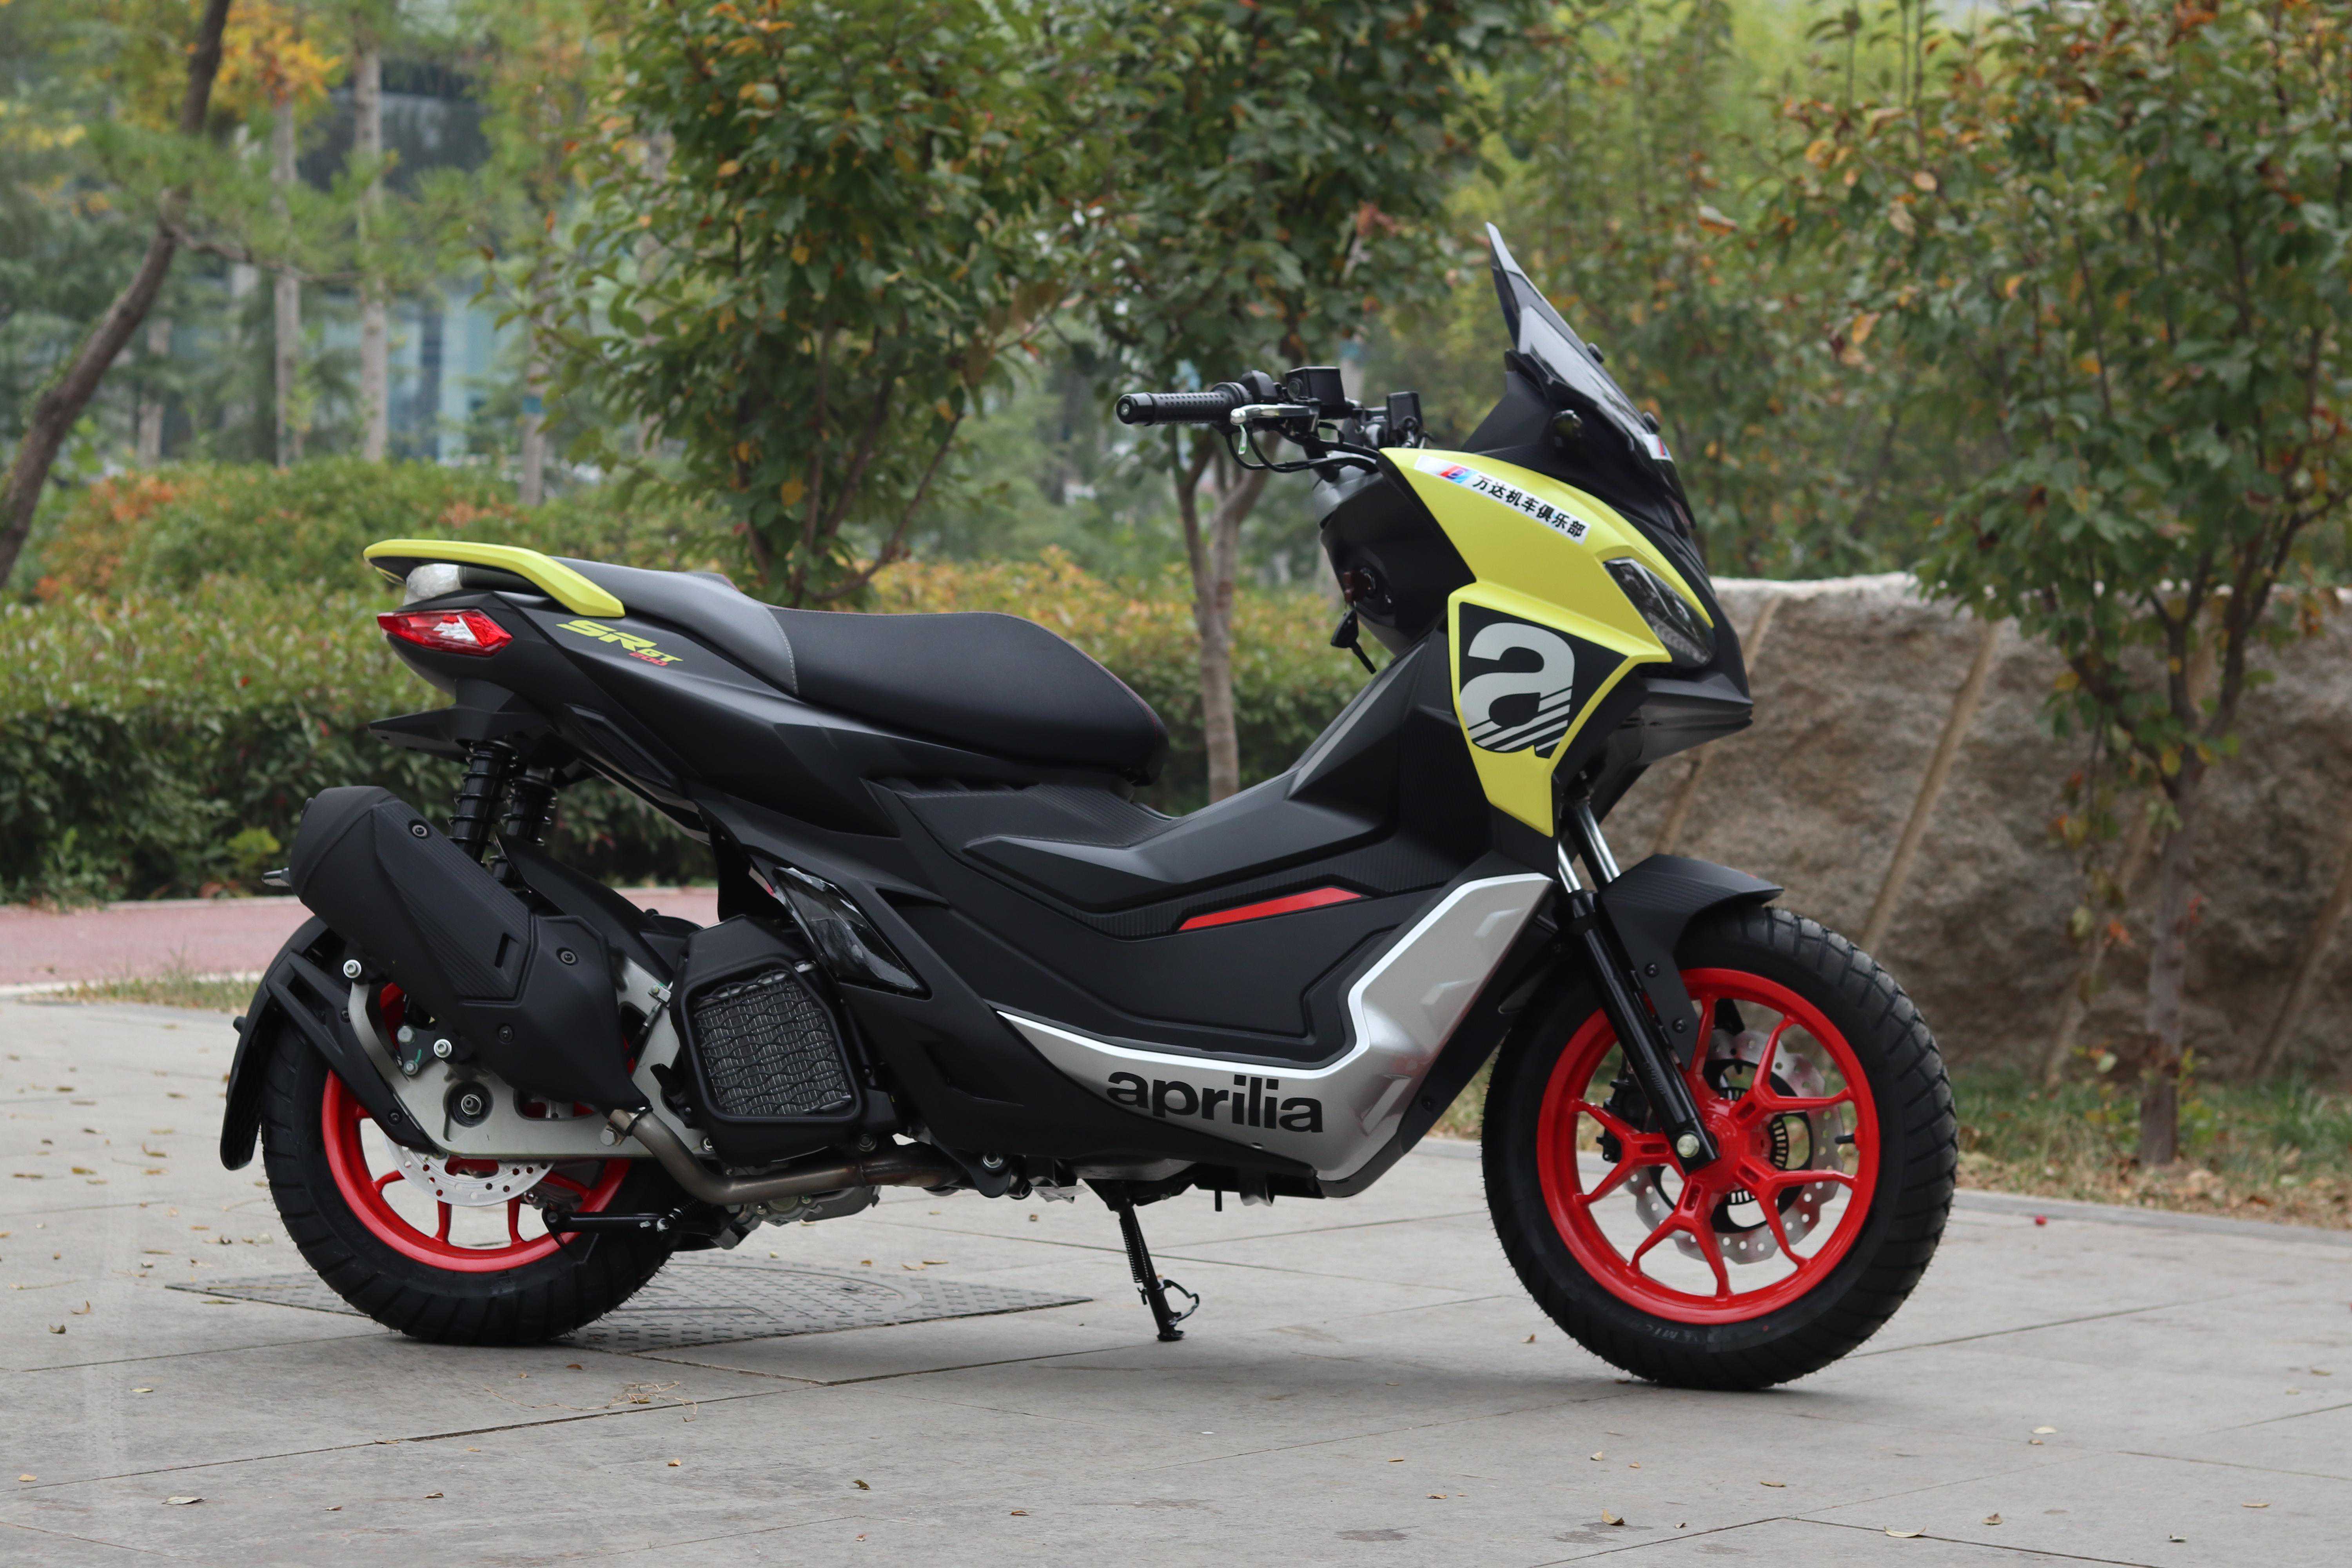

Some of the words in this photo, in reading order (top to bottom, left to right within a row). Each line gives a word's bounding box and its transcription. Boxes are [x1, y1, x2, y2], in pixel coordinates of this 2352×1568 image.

[1472, 475, 1586, 537] 万达机车俱乐部
[555, 619, 657, 652] SR
[637, 648, 684, 662] GT
[1106, 1071, 1323, 1133] aprilia
